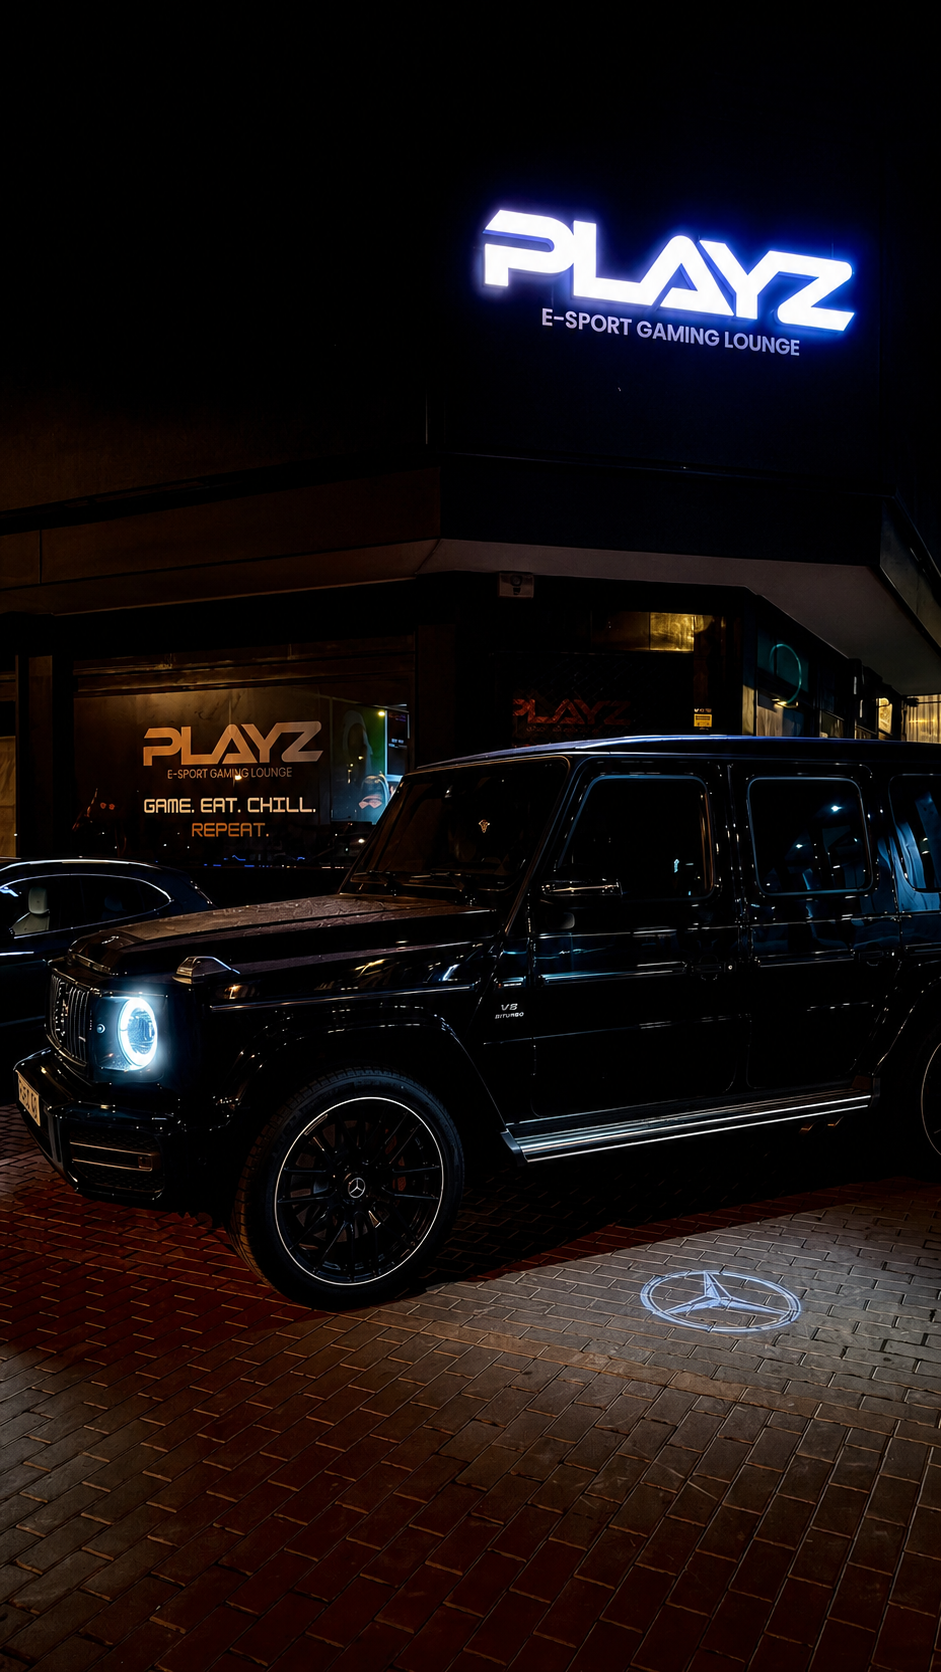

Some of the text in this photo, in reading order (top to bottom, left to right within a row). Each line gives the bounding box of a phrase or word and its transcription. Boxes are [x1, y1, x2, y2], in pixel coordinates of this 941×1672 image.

[484, 209, 855, 332] PLAYZ
[541, 307, 800, 356] E-SPORT GAMING LOUNGE
[511, 698, 632, 725] PLAYZ
[143, 720, 324, 767] PLAYZ
[167, 766, 293, 780] E-SPORT GAMING LOUNGE
[143, 797, 316, 814] GAME. EAT. CHILL.
[191, 822, 269, 838] REPEAT.
[494, 1011, 525, 1019] BITURBO
[500, 1002, 519, 1011] V8
